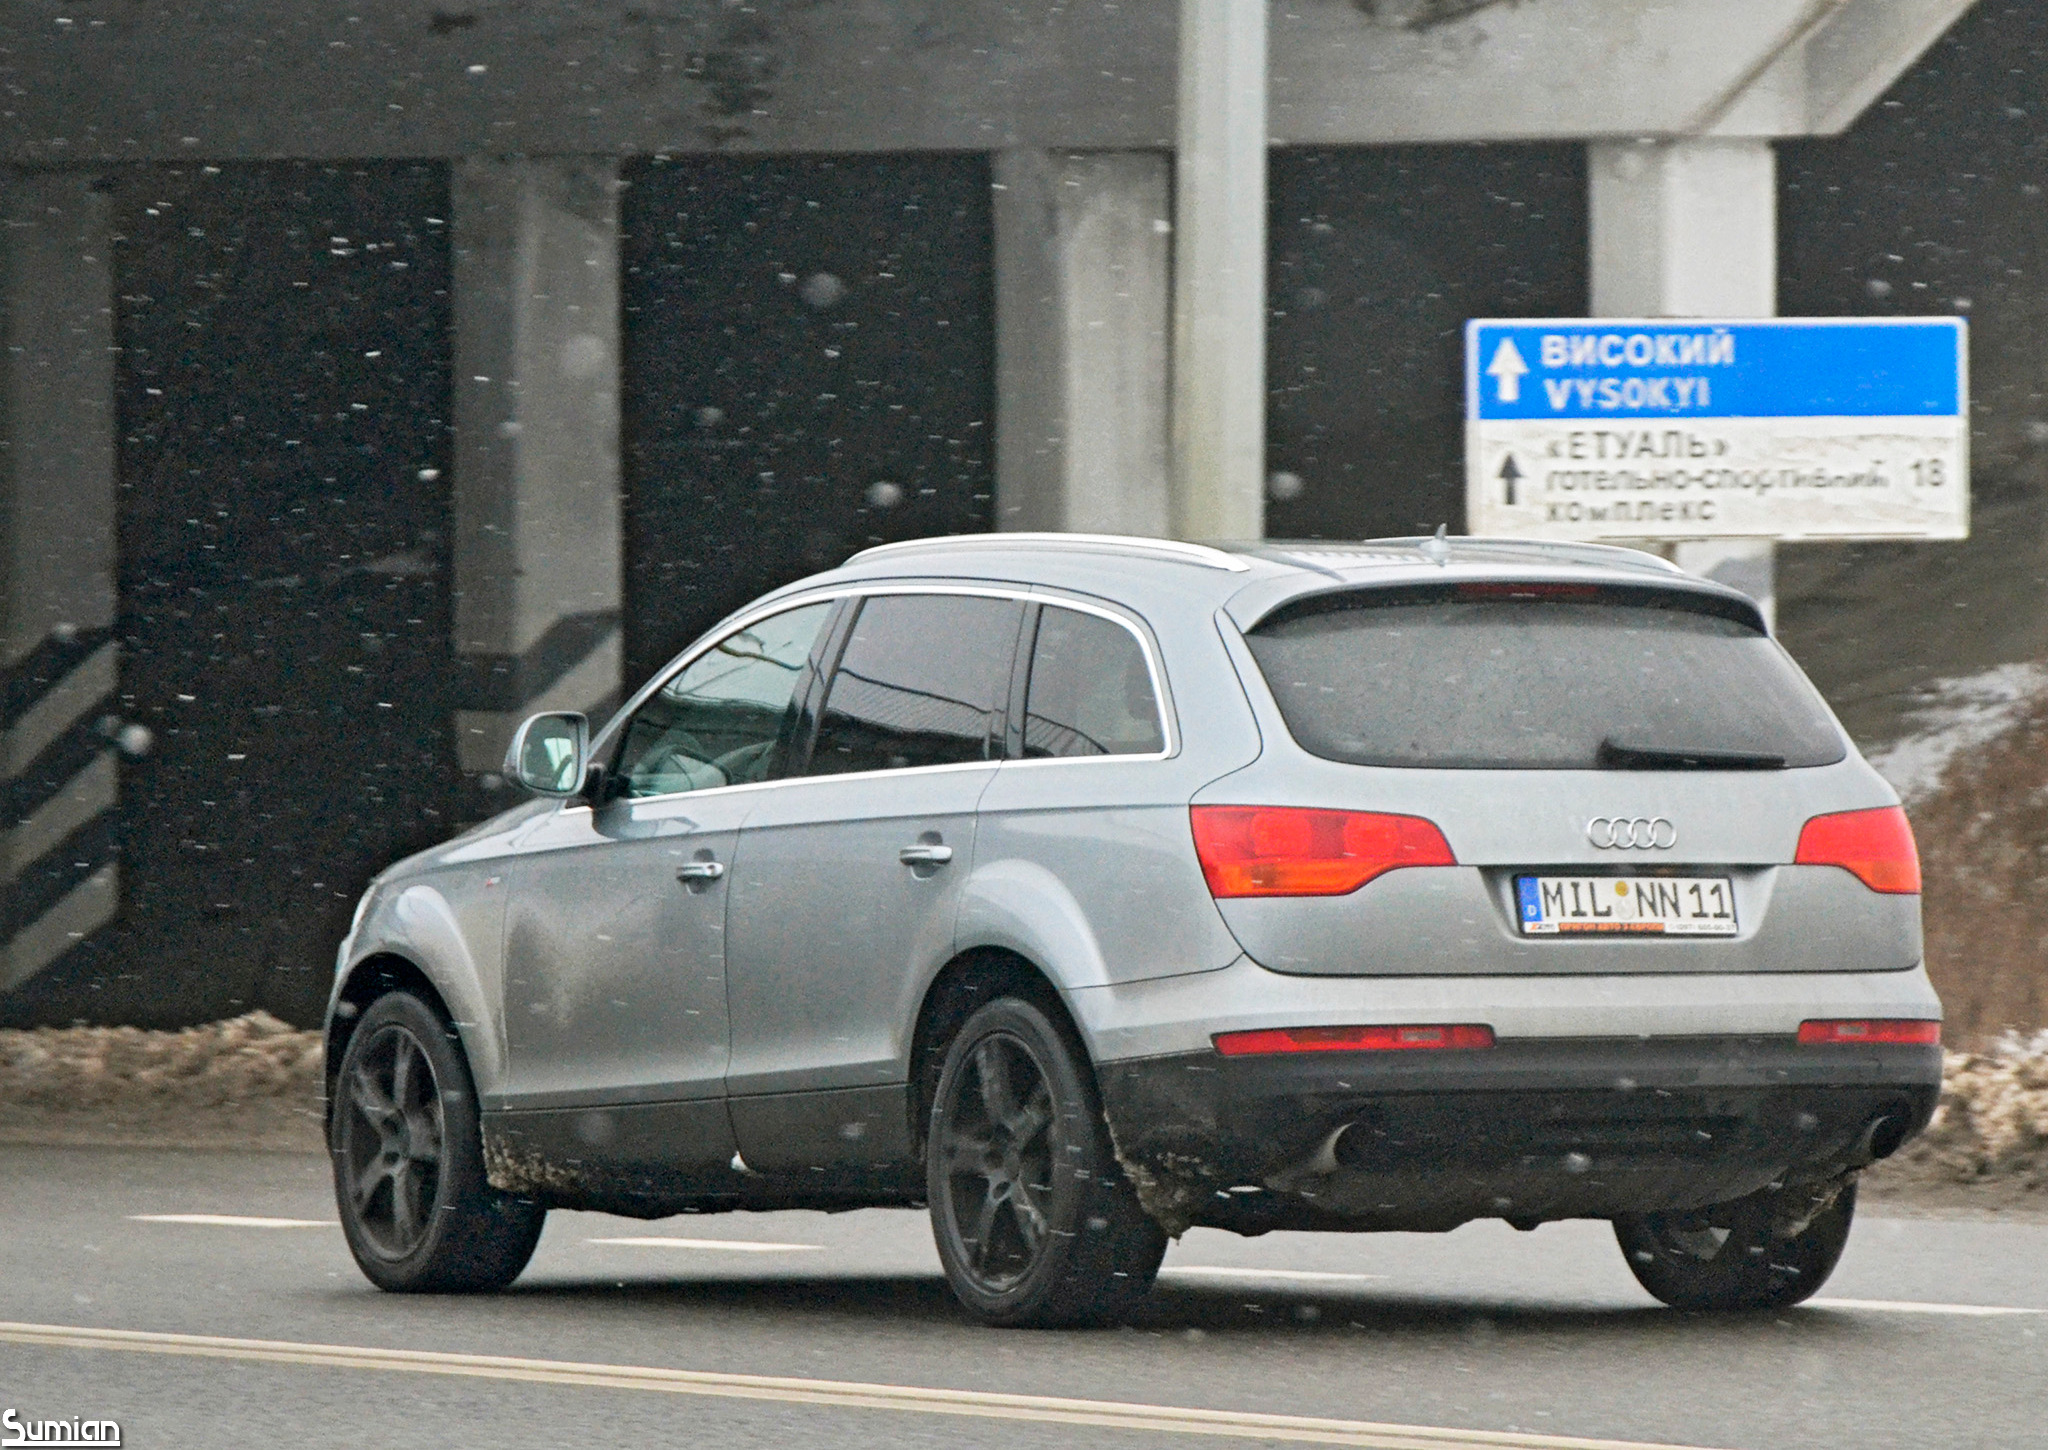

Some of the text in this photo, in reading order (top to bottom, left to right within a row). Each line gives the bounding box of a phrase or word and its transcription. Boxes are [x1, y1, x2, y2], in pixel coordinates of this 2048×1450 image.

[1541, 328, 1735, 366] ВИСОКИЙ
[1544, 376, 1711, 409] VYSOKYI
[1527, 904, 1538, 917] D
[1541, 881, 1731, 919] MIL NN 11
